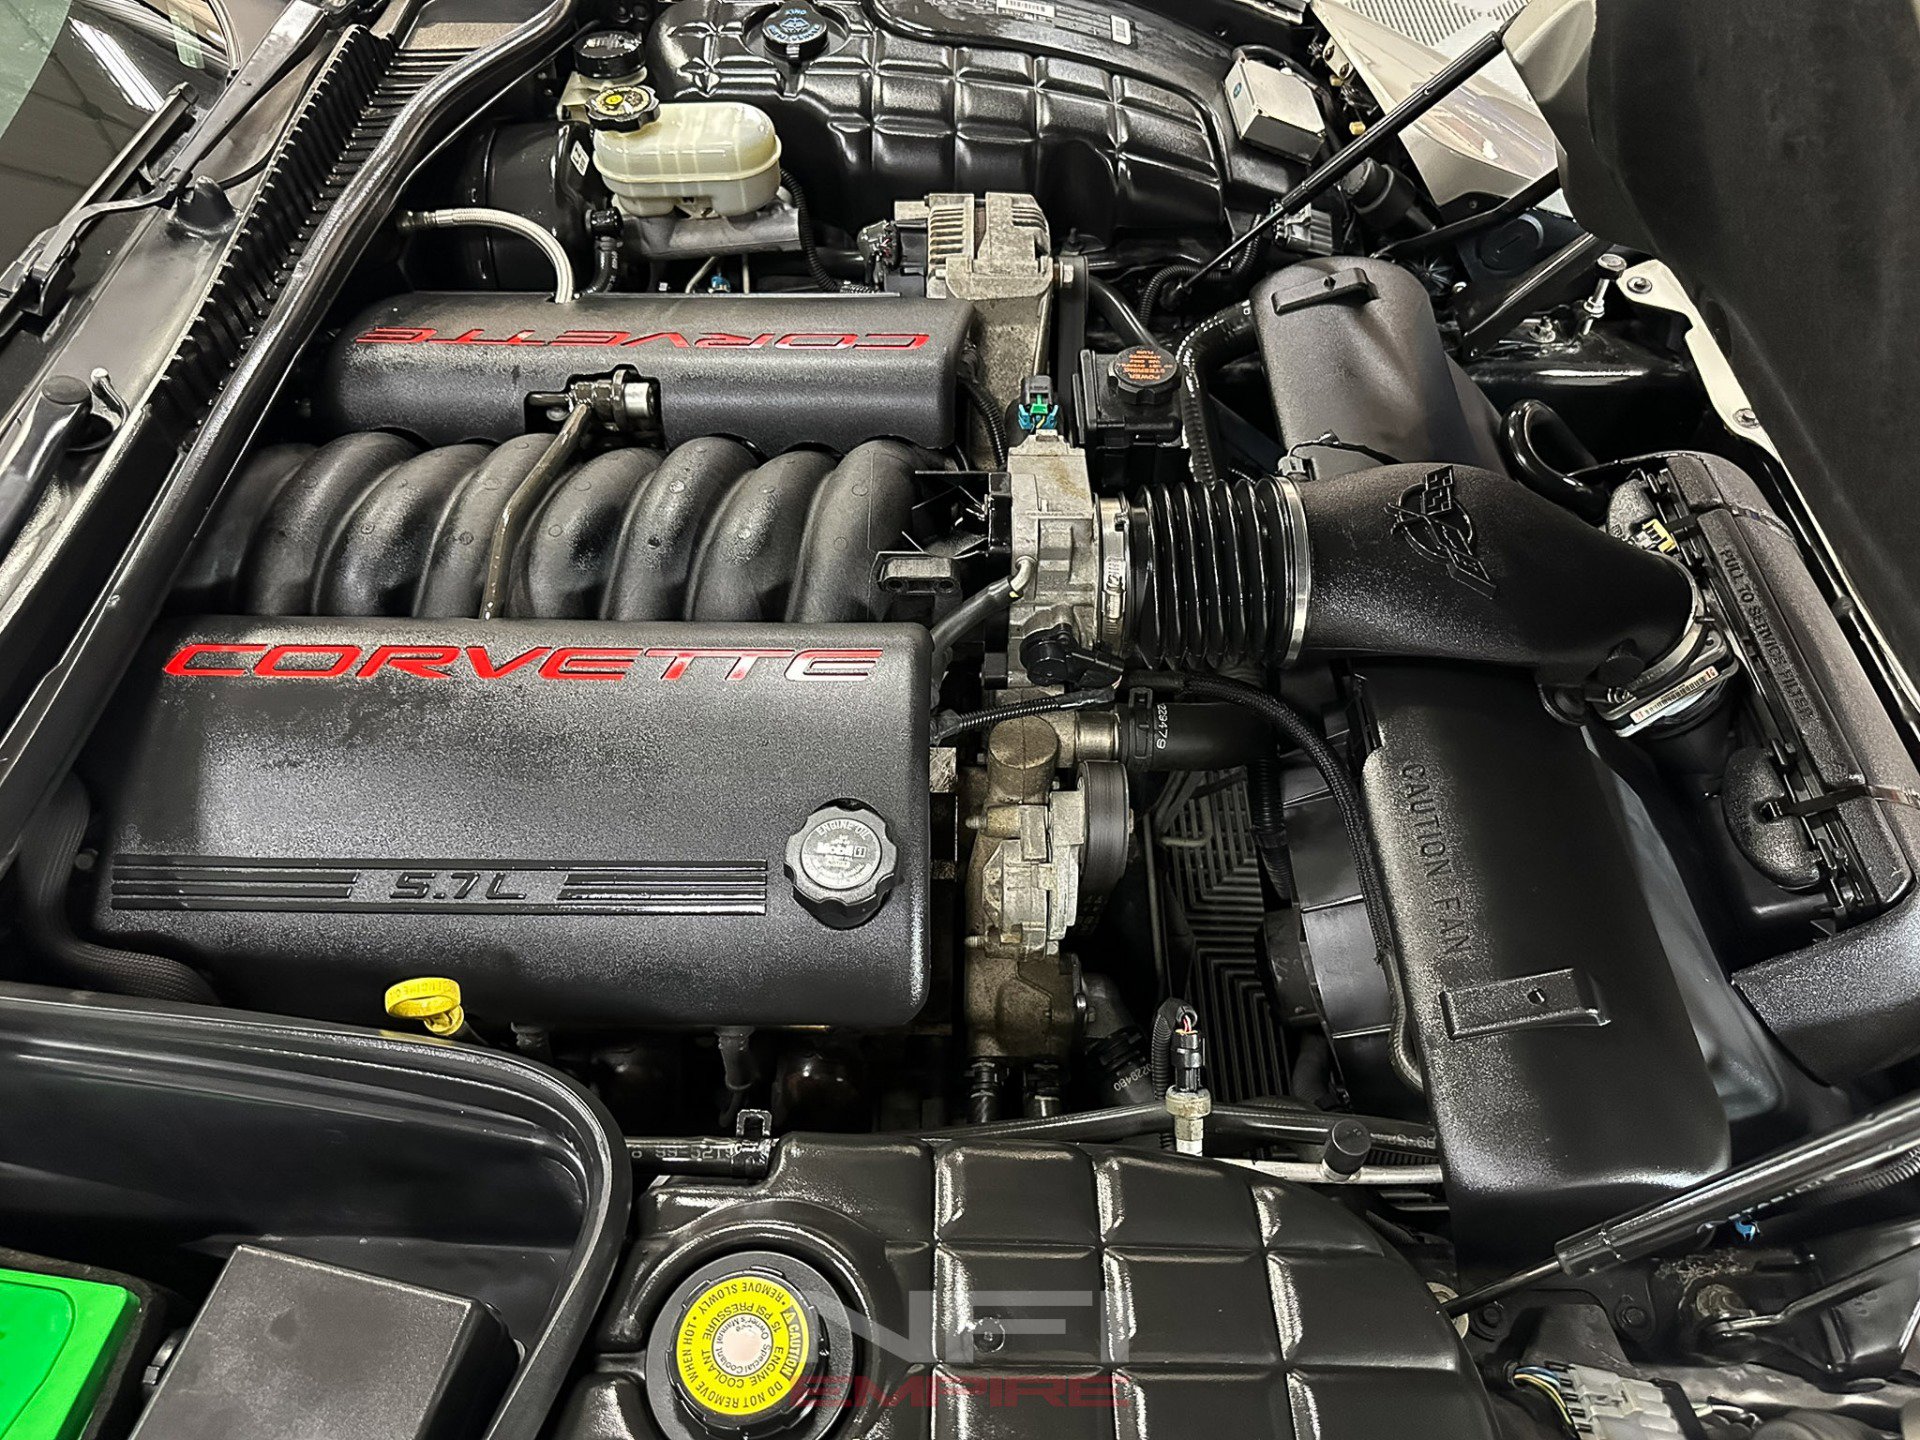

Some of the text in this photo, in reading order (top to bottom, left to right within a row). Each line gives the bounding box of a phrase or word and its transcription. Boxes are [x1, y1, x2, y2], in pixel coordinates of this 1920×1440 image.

[355, 326, 930, 349] CORVETTE
[1717, 547, 1815, 722] PULL TO SERVICE FILTER
[163, 643, 882, 681] CORVETTE
[816, 820, 856, 837] ENGINE
[855, 824, 871, 841] OIL
[816, 841, 854, 856] Mobil
[1402, 763, 1471, 957] CAUTION FAN
[389, 872, 527, 899] 5.7L
[698, 1282, 786, 1315] REMOVE SLOWLY
[755, 1305, 773, 1320] PSI
[702, 1302, 755, 1341] PRESSURE
[716, 1316, 769, 1346] Owner's Manual
[770, 1321, 783, 1333] 15
[682, 1322, 803, 1410] CAUTION DO NOT REMOVE WHEN HOT
[701, 1345, 784, 1389] ENGINE COOLANT
[716, 1343, 772, 1375] Special Coolant
